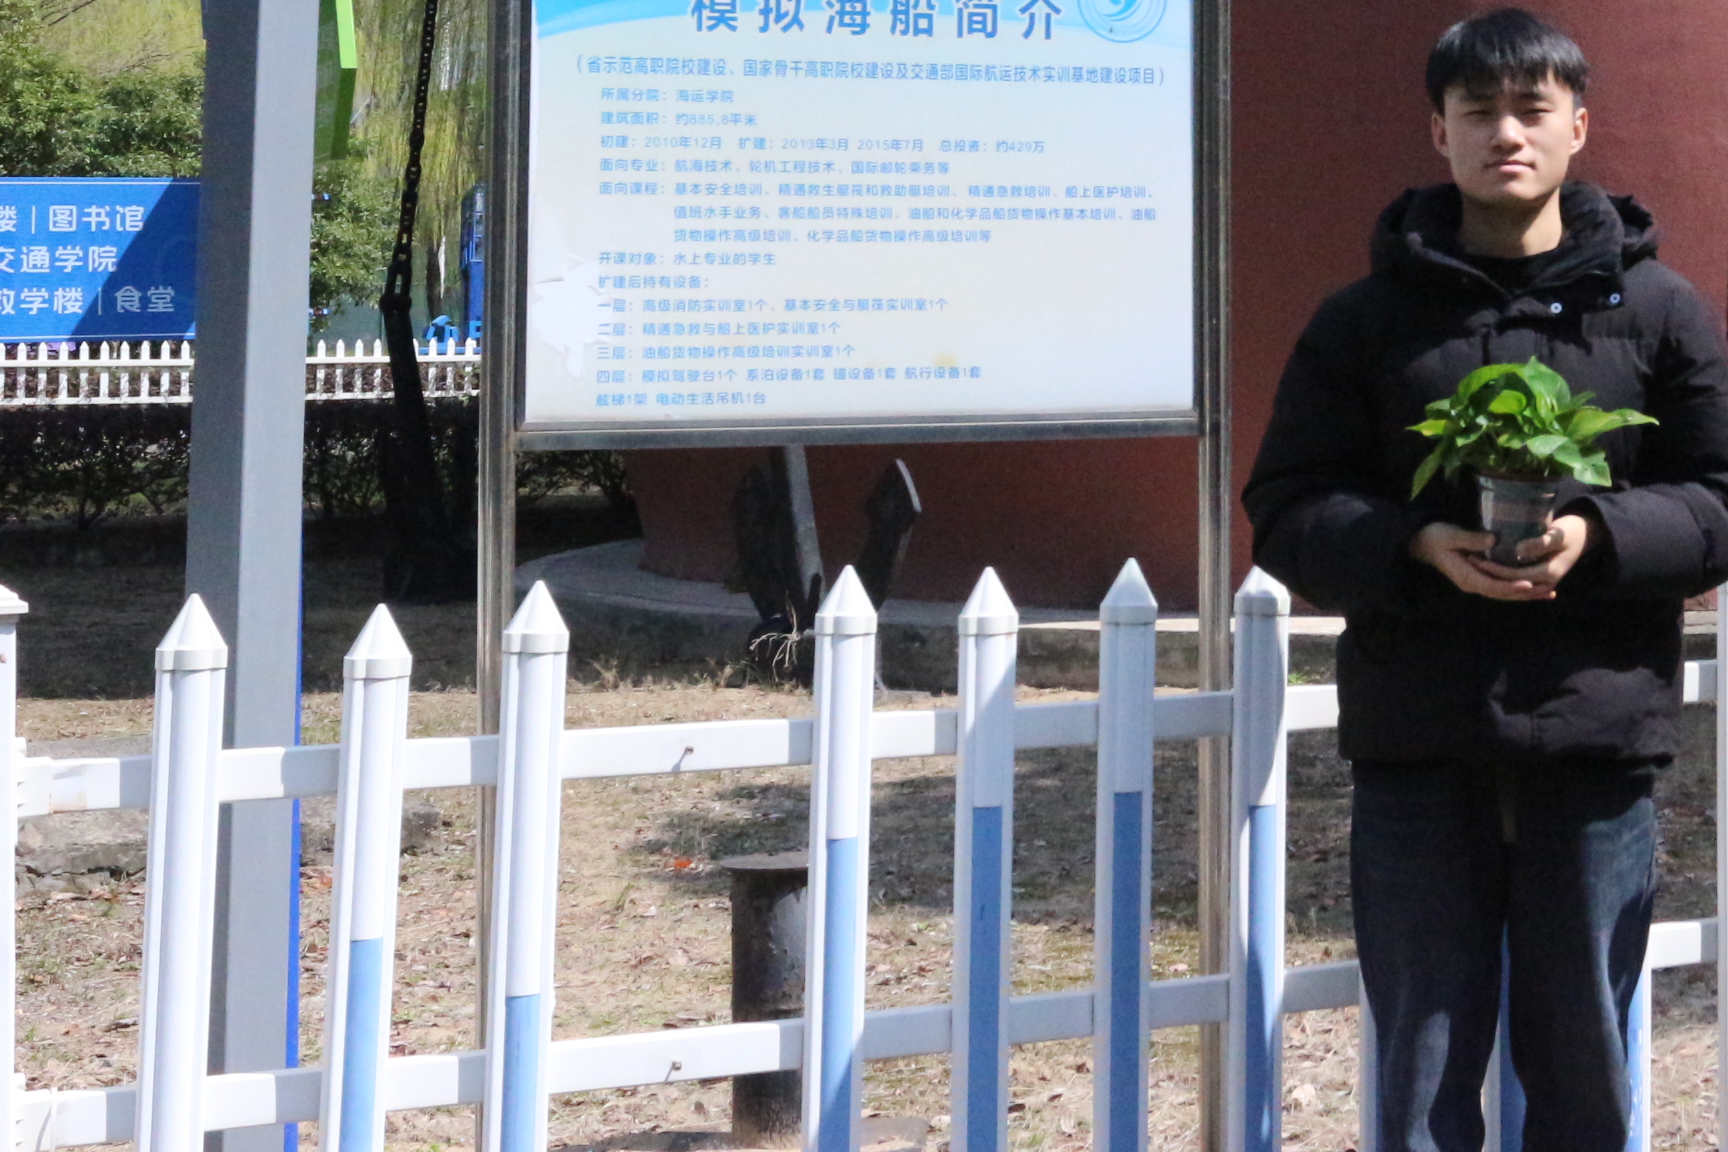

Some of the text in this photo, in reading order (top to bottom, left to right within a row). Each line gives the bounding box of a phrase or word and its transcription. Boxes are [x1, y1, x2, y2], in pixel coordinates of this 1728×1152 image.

[49, 204, 144, 232] 图书馆
[114, 285, 175, 313] 食堂
